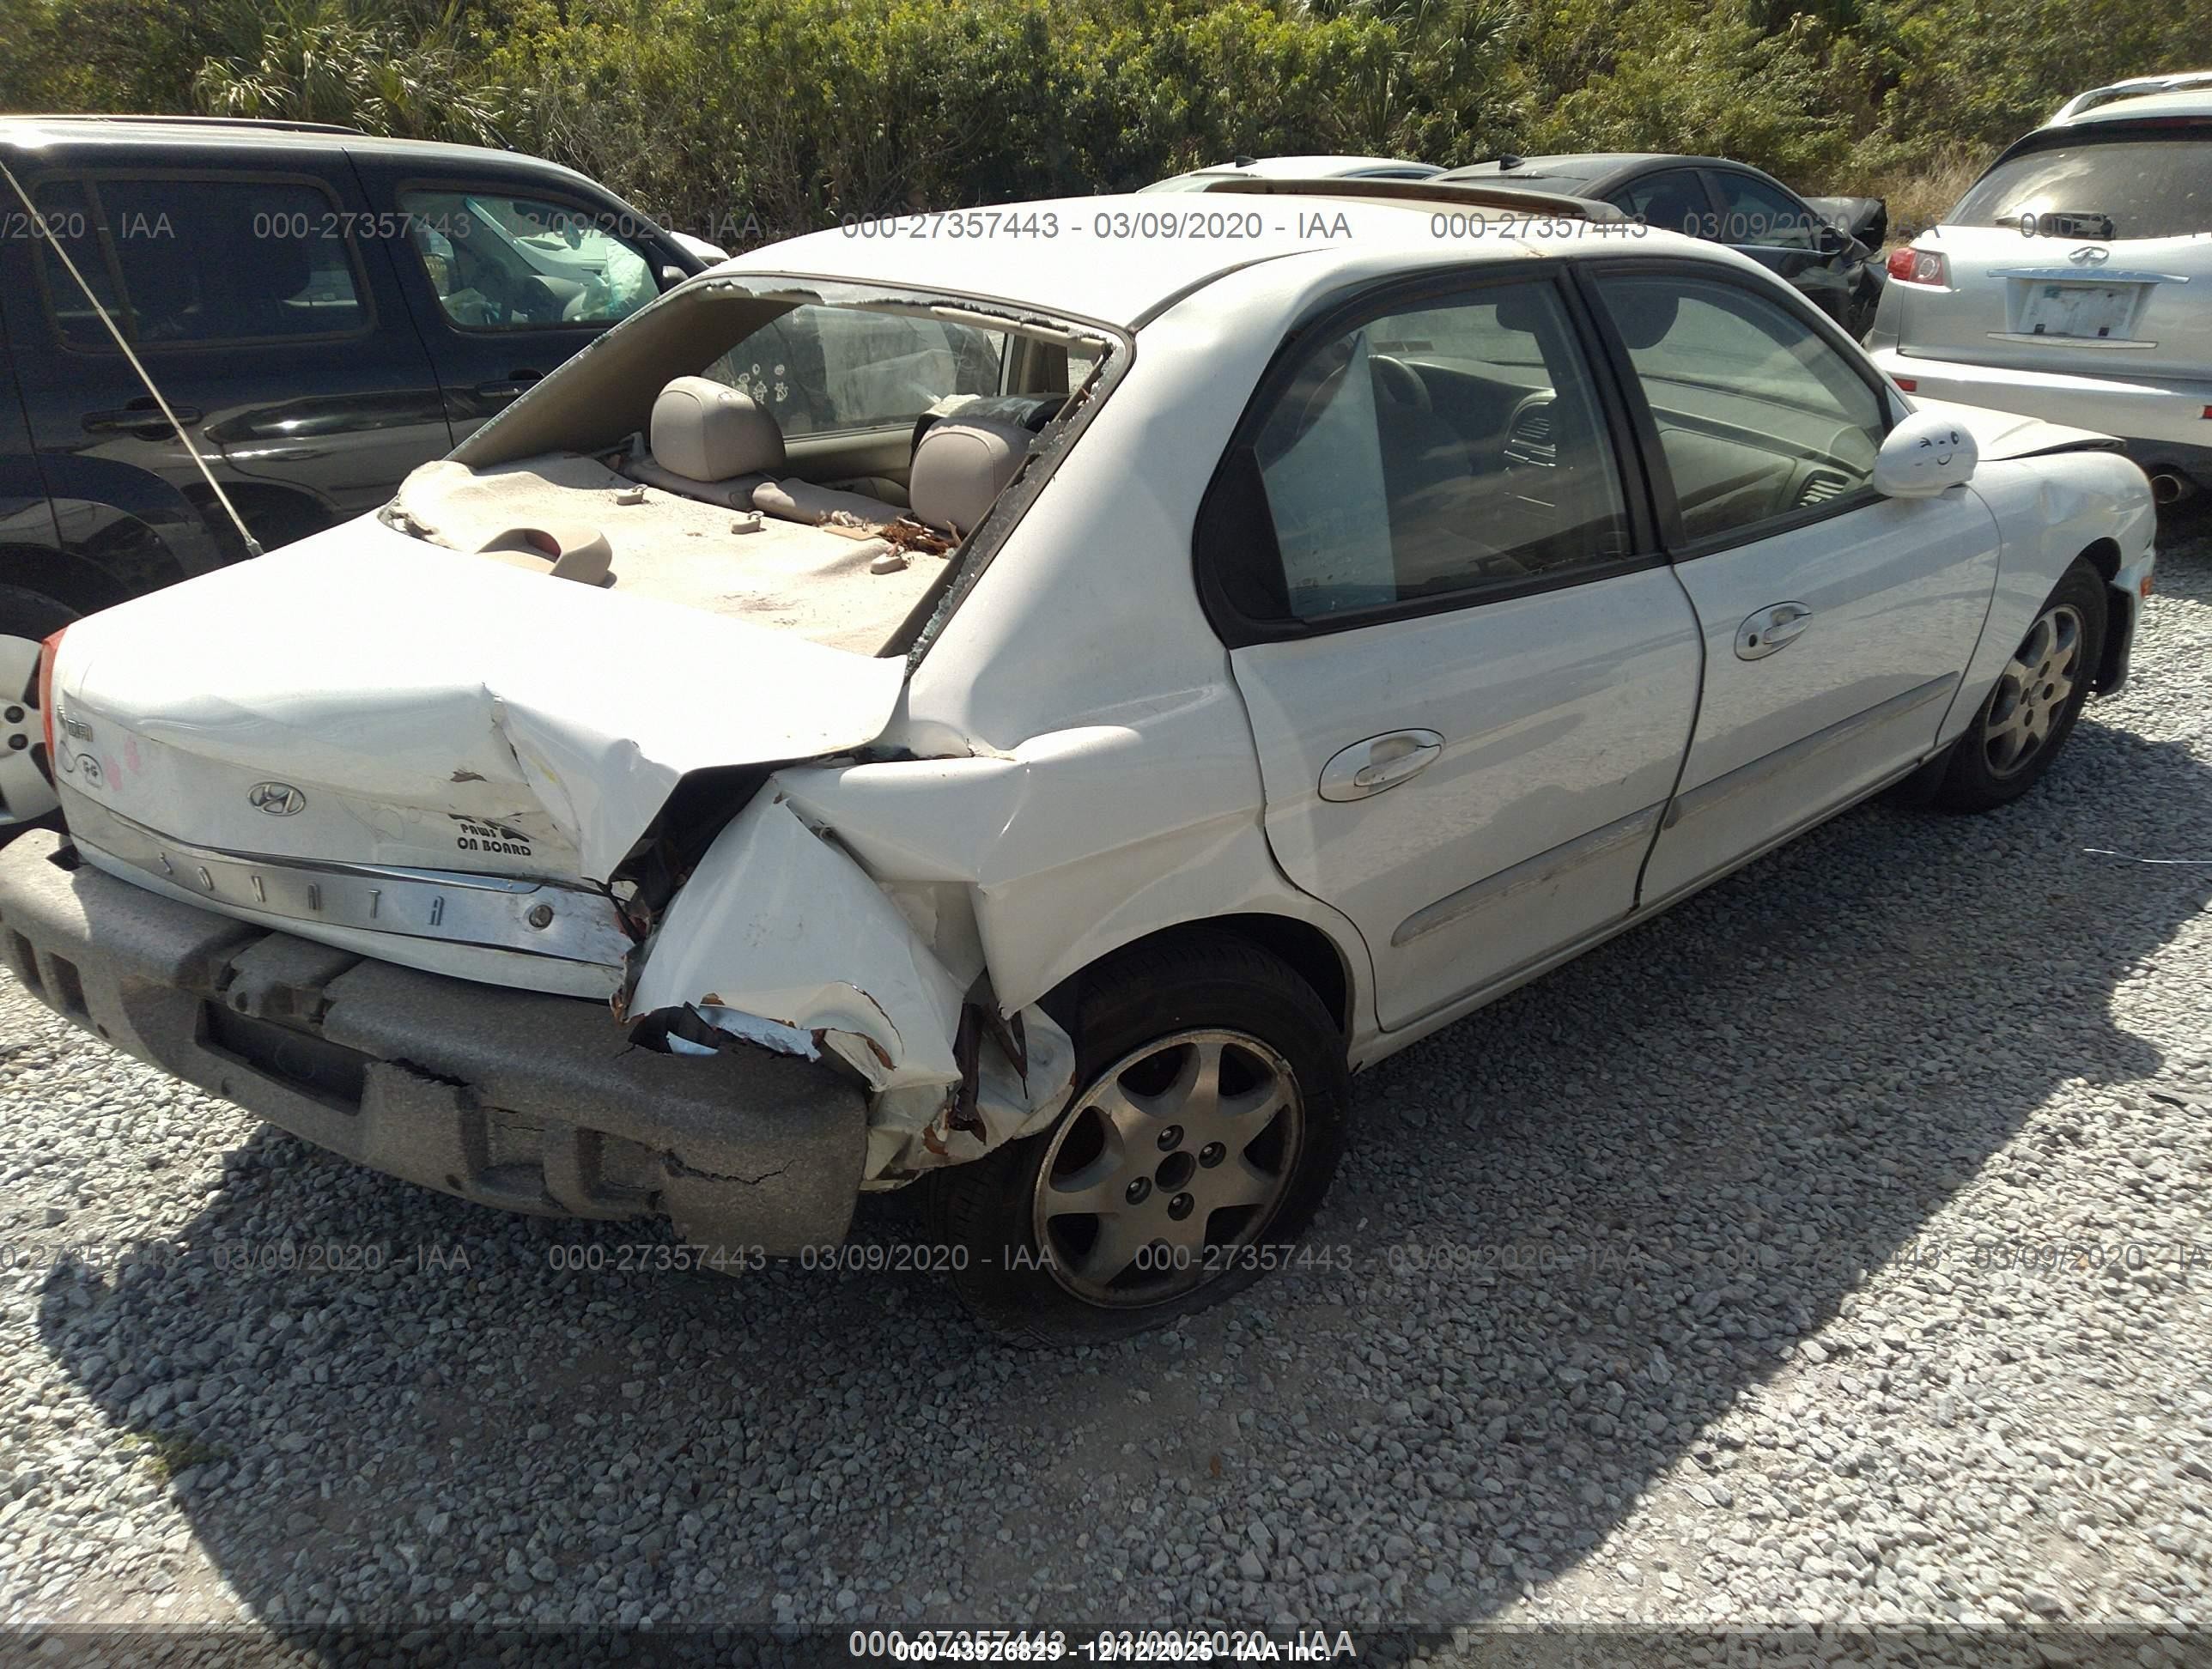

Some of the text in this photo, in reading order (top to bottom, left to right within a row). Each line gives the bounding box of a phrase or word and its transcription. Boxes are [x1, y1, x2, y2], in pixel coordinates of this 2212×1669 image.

[459, 822, 497, 838] PAWS
[457, 836, 532, 856] ON BOARD
[156, 851, 445, 927] SONATA
